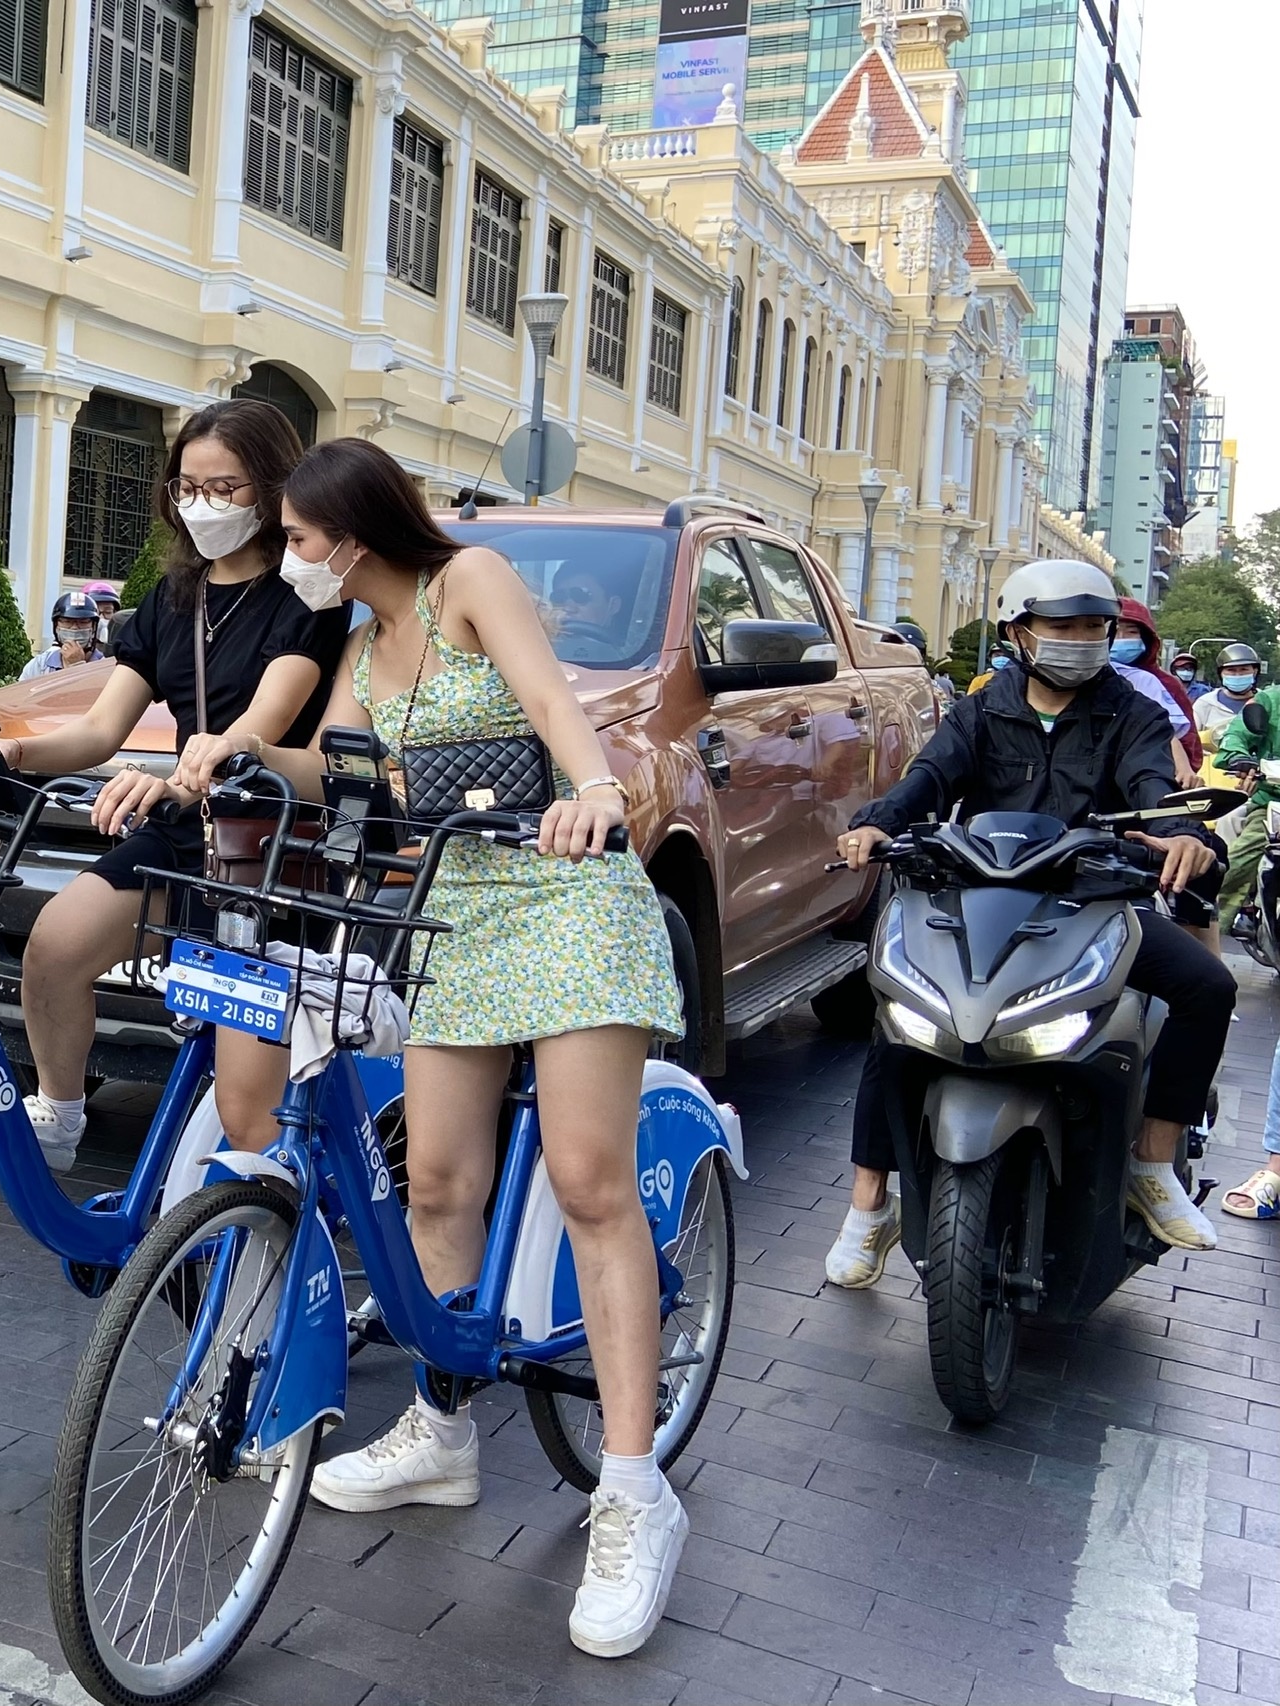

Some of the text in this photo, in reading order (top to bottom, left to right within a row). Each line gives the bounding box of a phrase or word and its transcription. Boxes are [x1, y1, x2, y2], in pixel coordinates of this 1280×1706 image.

[680, 2, 729, 15] VINFAST
[680, 58, 719, 69] VINFAST
[661, 69, 697, 80] MOBILE
[988, 832, 1029, 840] HONDA
[658, 1094, 681, 1113] Cuộc
[682, 1097, 702, 1122] sống
[306, 1264, 331, 1304] TN
